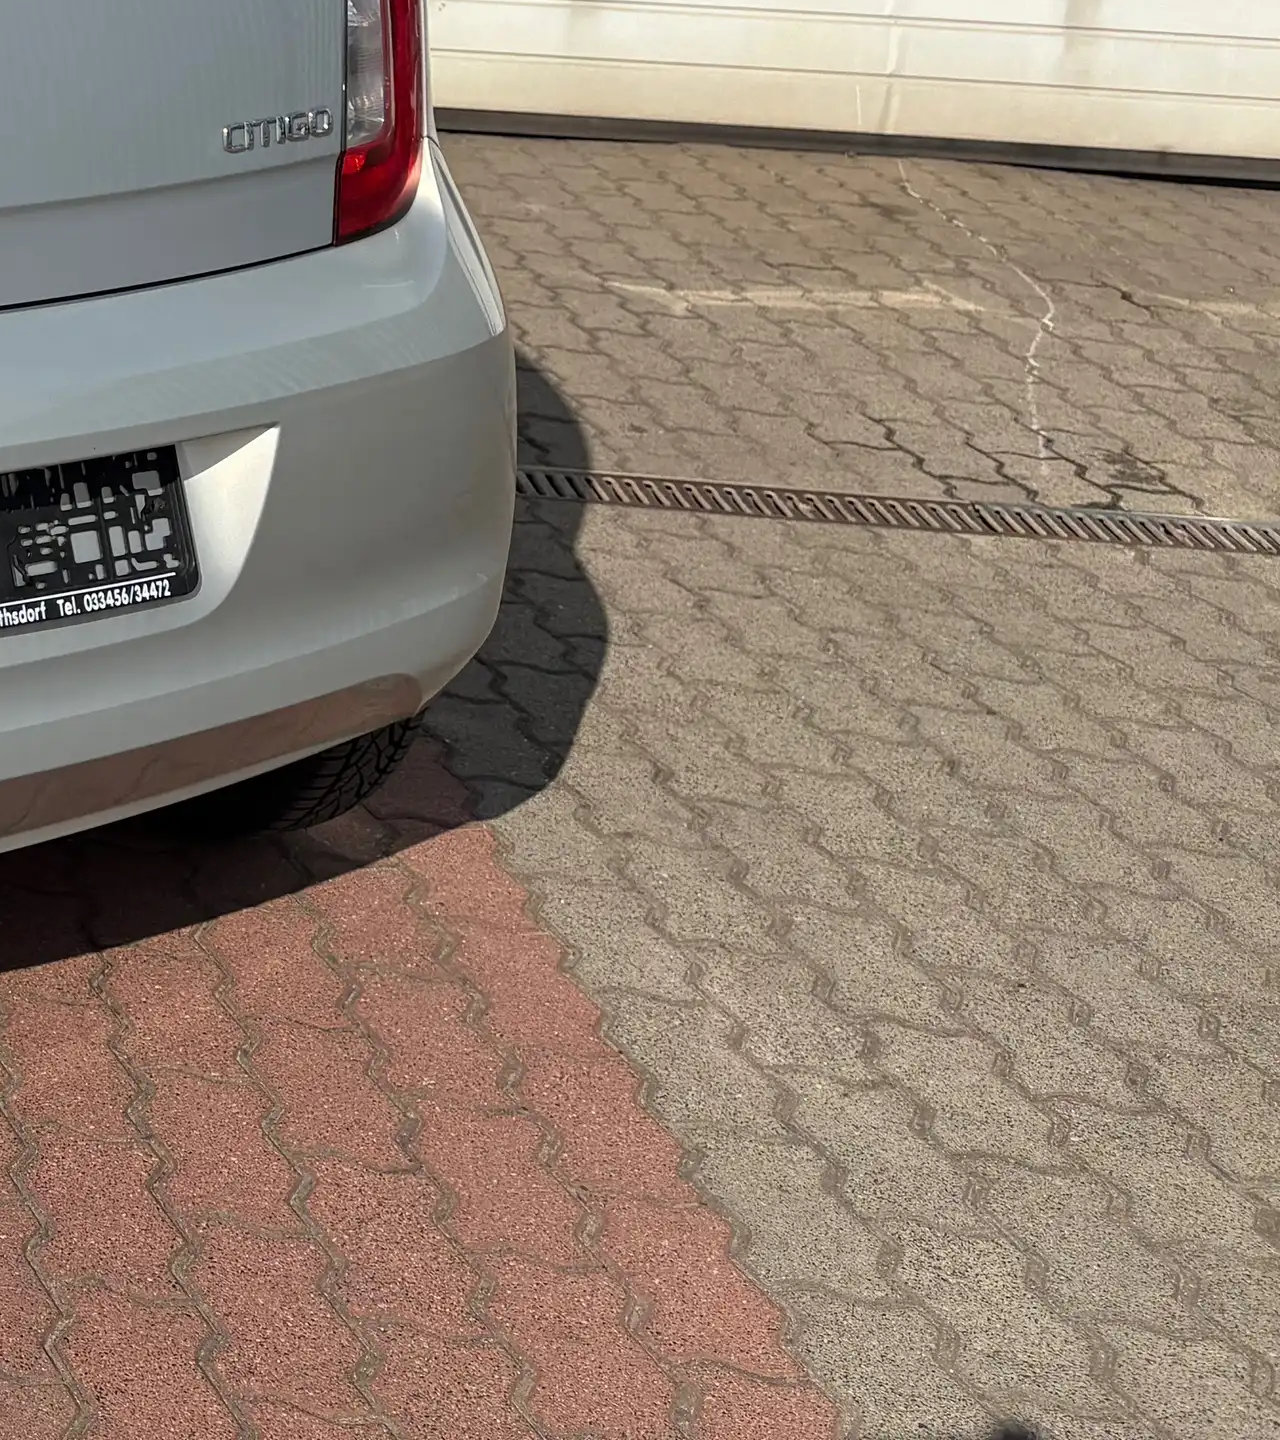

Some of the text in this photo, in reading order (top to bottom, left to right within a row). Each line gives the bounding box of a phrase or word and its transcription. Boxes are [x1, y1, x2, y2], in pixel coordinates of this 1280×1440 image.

[222, 108, 334, 154] CITIGO
[56, 597, 82, 617] Tel.
[83, 578, 172, 612] 033456/34472
